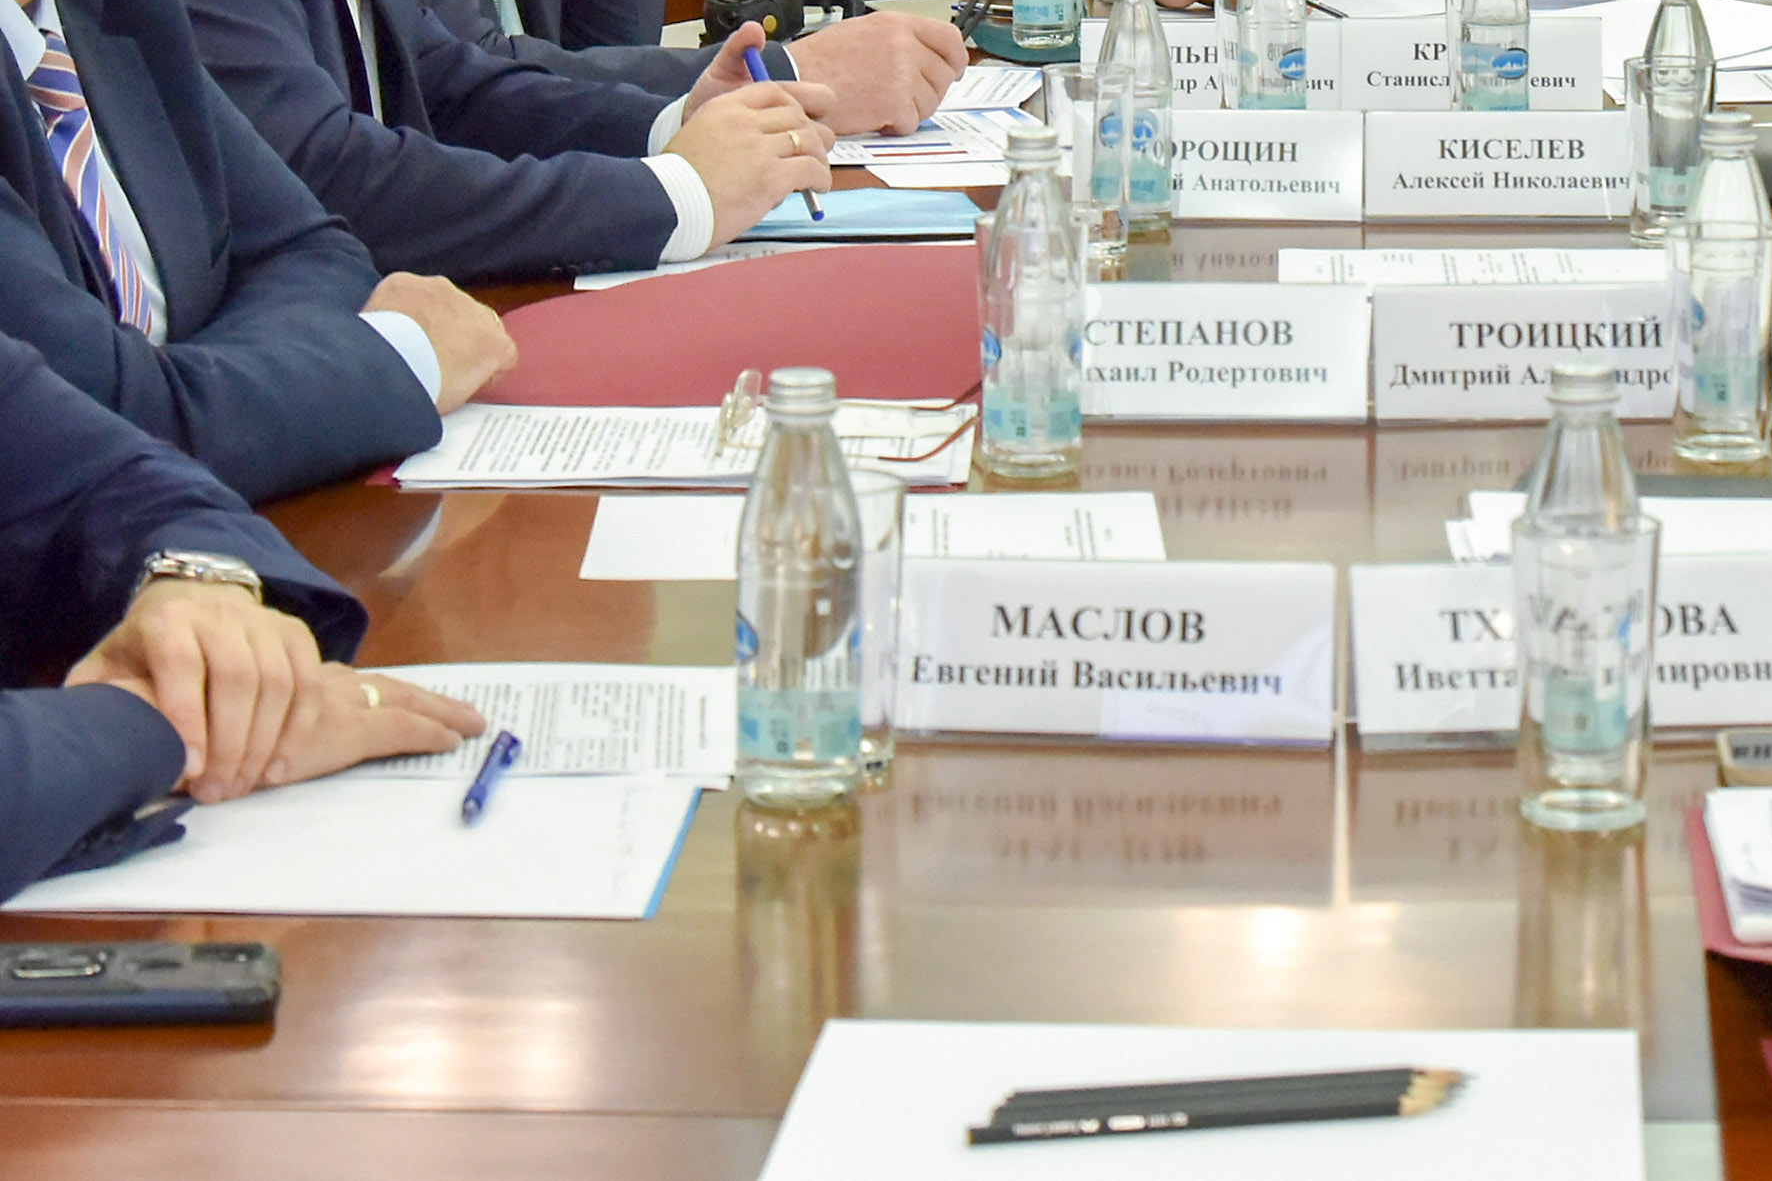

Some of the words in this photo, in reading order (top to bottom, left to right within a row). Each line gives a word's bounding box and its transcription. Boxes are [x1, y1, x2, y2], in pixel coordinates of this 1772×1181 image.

[1366, 70, 1450, 88] Станисл
[1437, 138, 1586, 160] КИСЕЛЕВ
[1191, 174, 1341, 194] Анатольевич
[1392, 171, 1485, 190] Алексей
[1493, 171, 1631, 190] Николаевич
[1083, 320, 1294, 347] СТЕПАНОВ
[1449, 315, 1664, 352] ТРОИЦКИЙ
[1167, 361, 1329, 389] Родертович
[1389, 364, 1512, 391] Дмитрий
[990, 604, 1208, 644] МАСЛОВ
[912, 655, 1059, 689] Евгений
[1072, 660, 1283, 696] Васильевич
